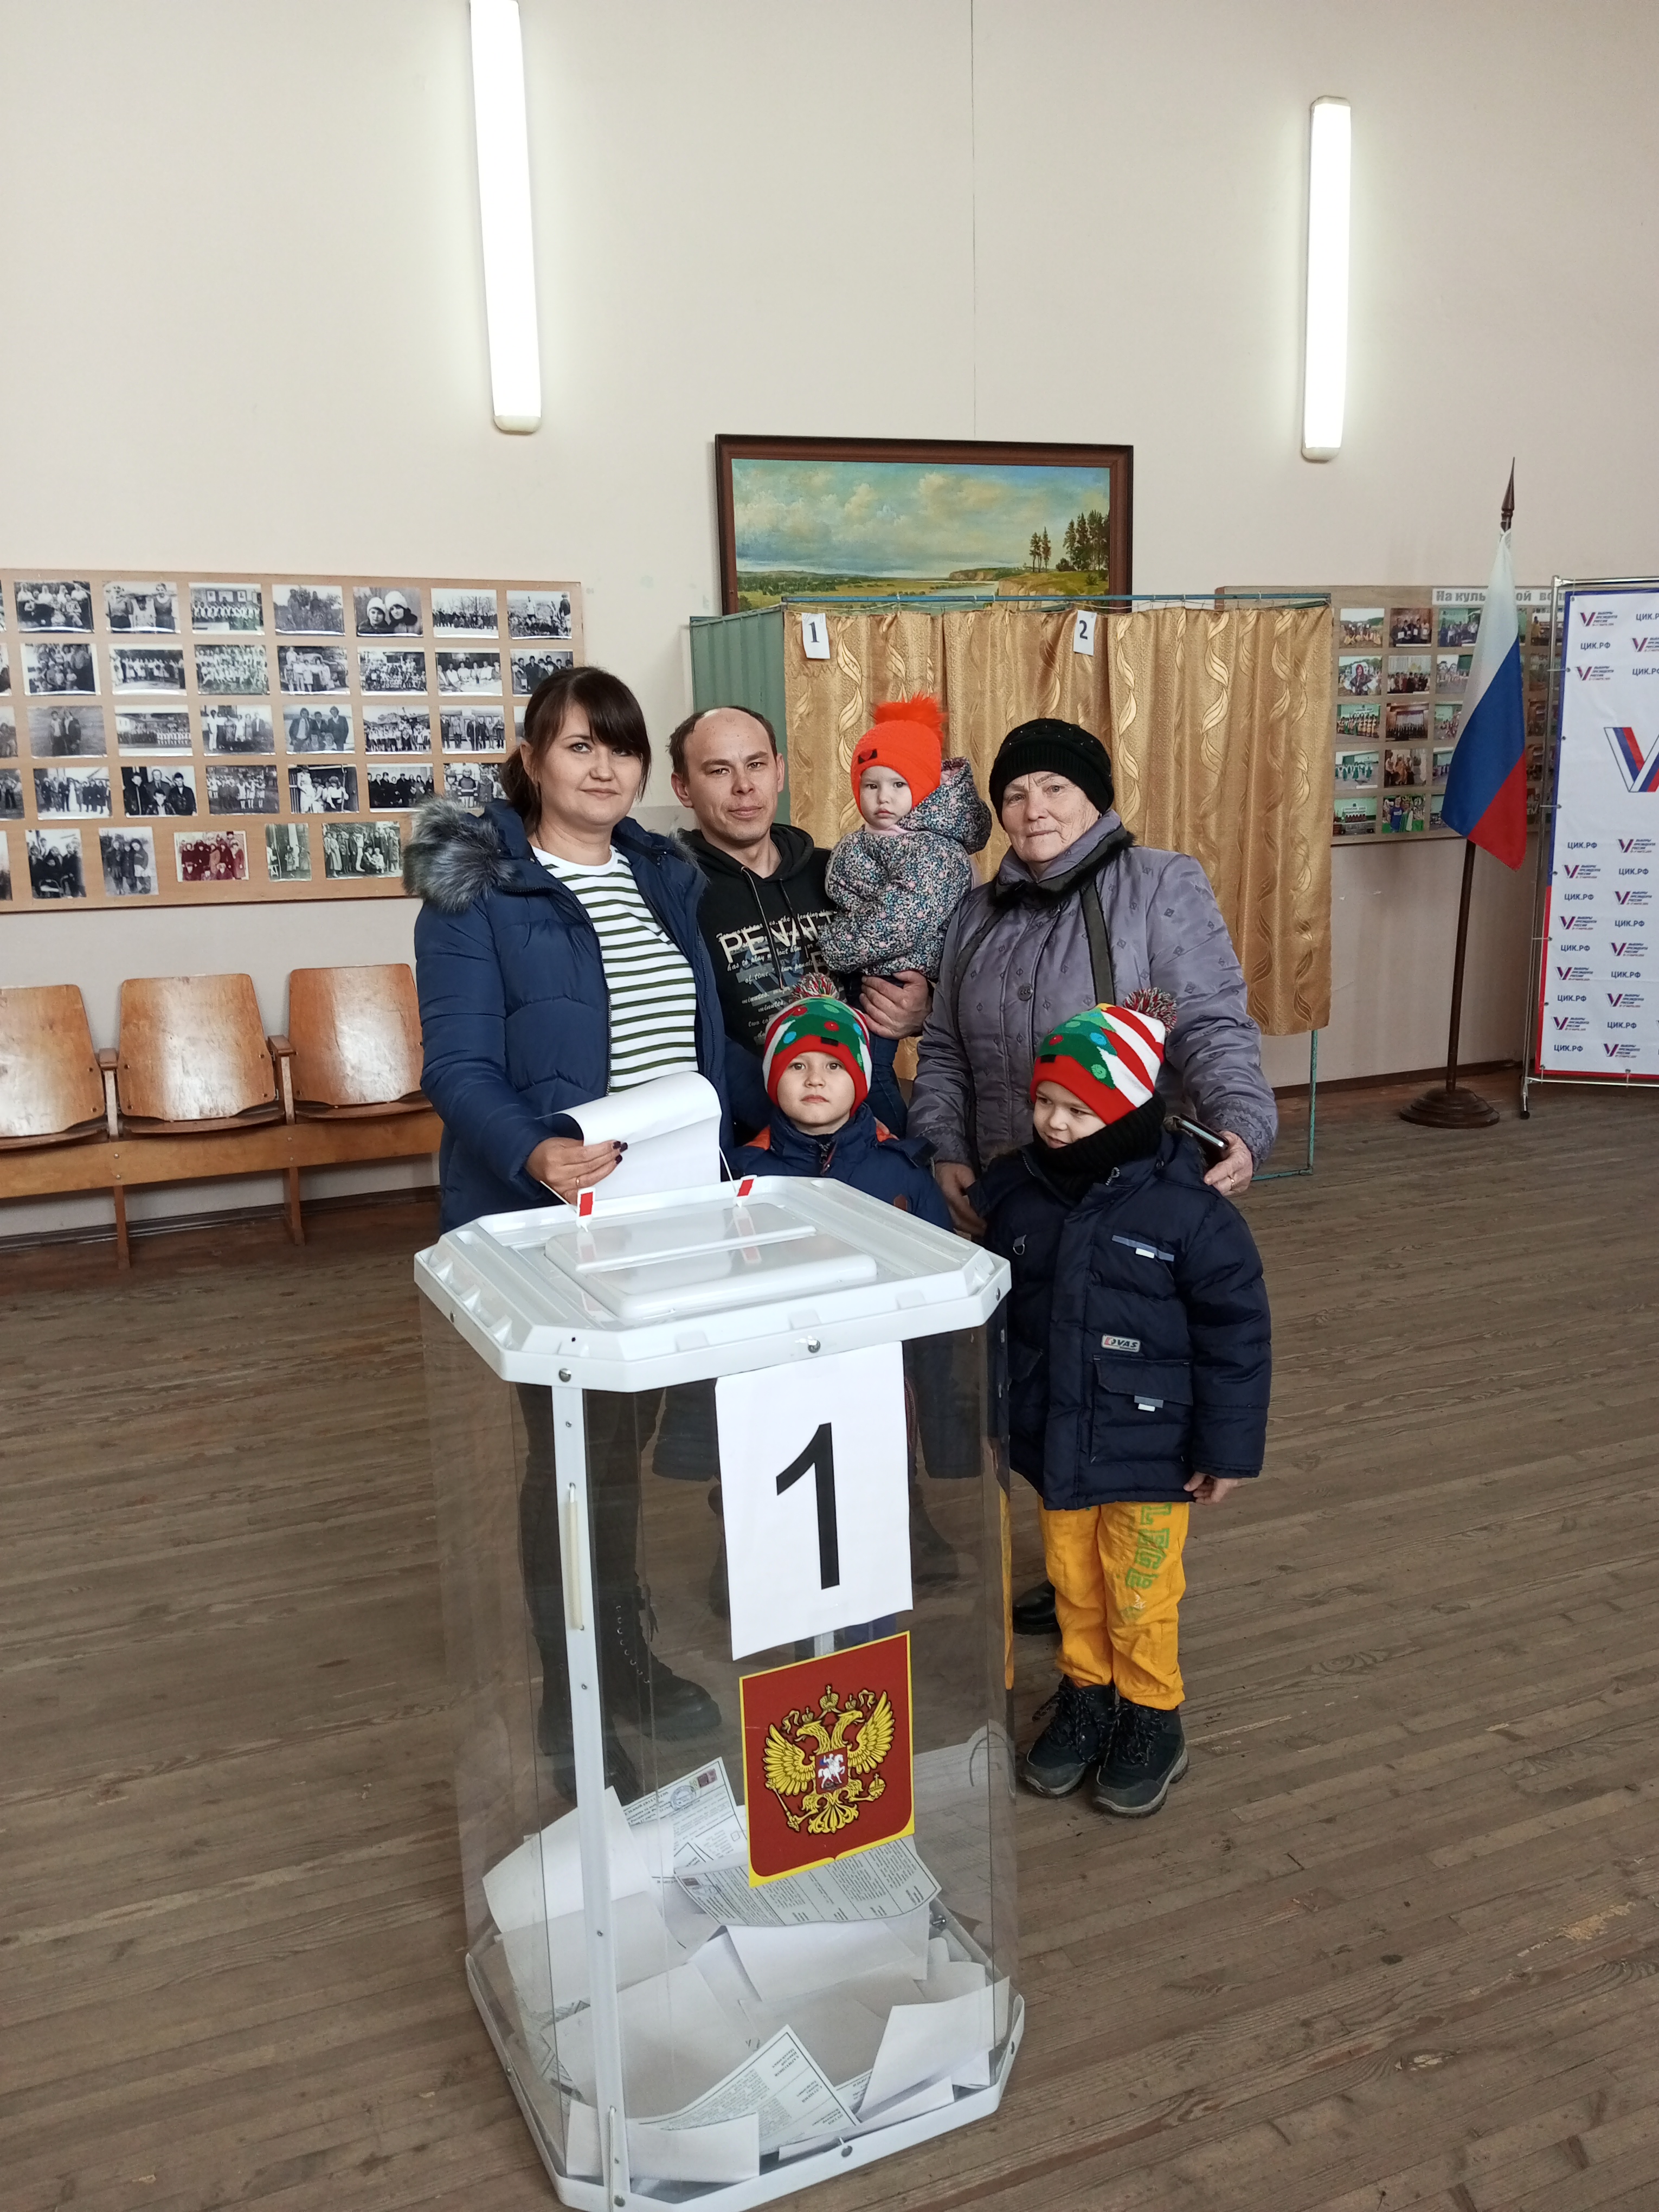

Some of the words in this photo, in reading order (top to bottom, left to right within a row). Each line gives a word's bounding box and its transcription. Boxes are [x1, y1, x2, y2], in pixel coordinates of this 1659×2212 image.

[1436, 590, 1452, 601] На
[1636, 613, 1659, 621] ЦИК.Р
[808, 621, 820, 642] 1
[1079, 620, 1088, 640] 2
[1580, 642, 1610, 650] ЦИК.РФ
[776, 1422, 840, 1590] 1
